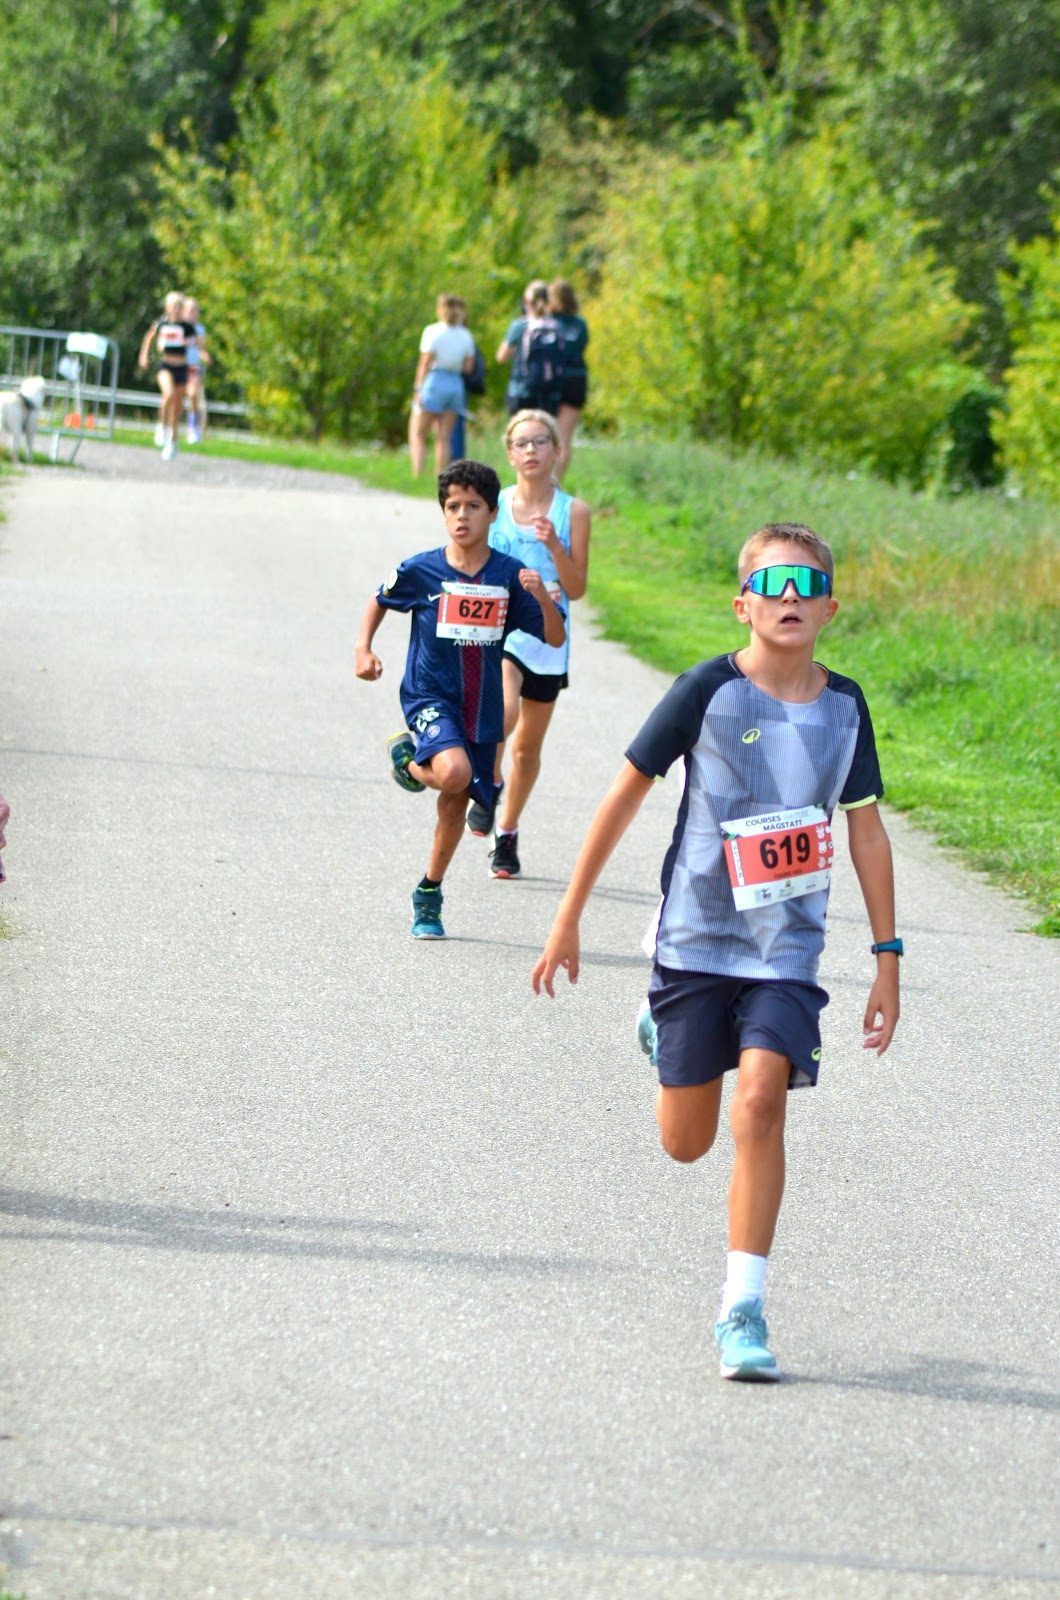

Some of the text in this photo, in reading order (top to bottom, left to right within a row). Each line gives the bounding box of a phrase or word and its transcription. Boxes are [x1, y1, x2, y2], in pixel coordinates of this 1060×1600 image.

[459, 599, 495, 619] 627
[746, 815, 782, 827] COURSES
[763, 819, 803, 831] MAGSTATT
[760, 832, 811, 869] 619
